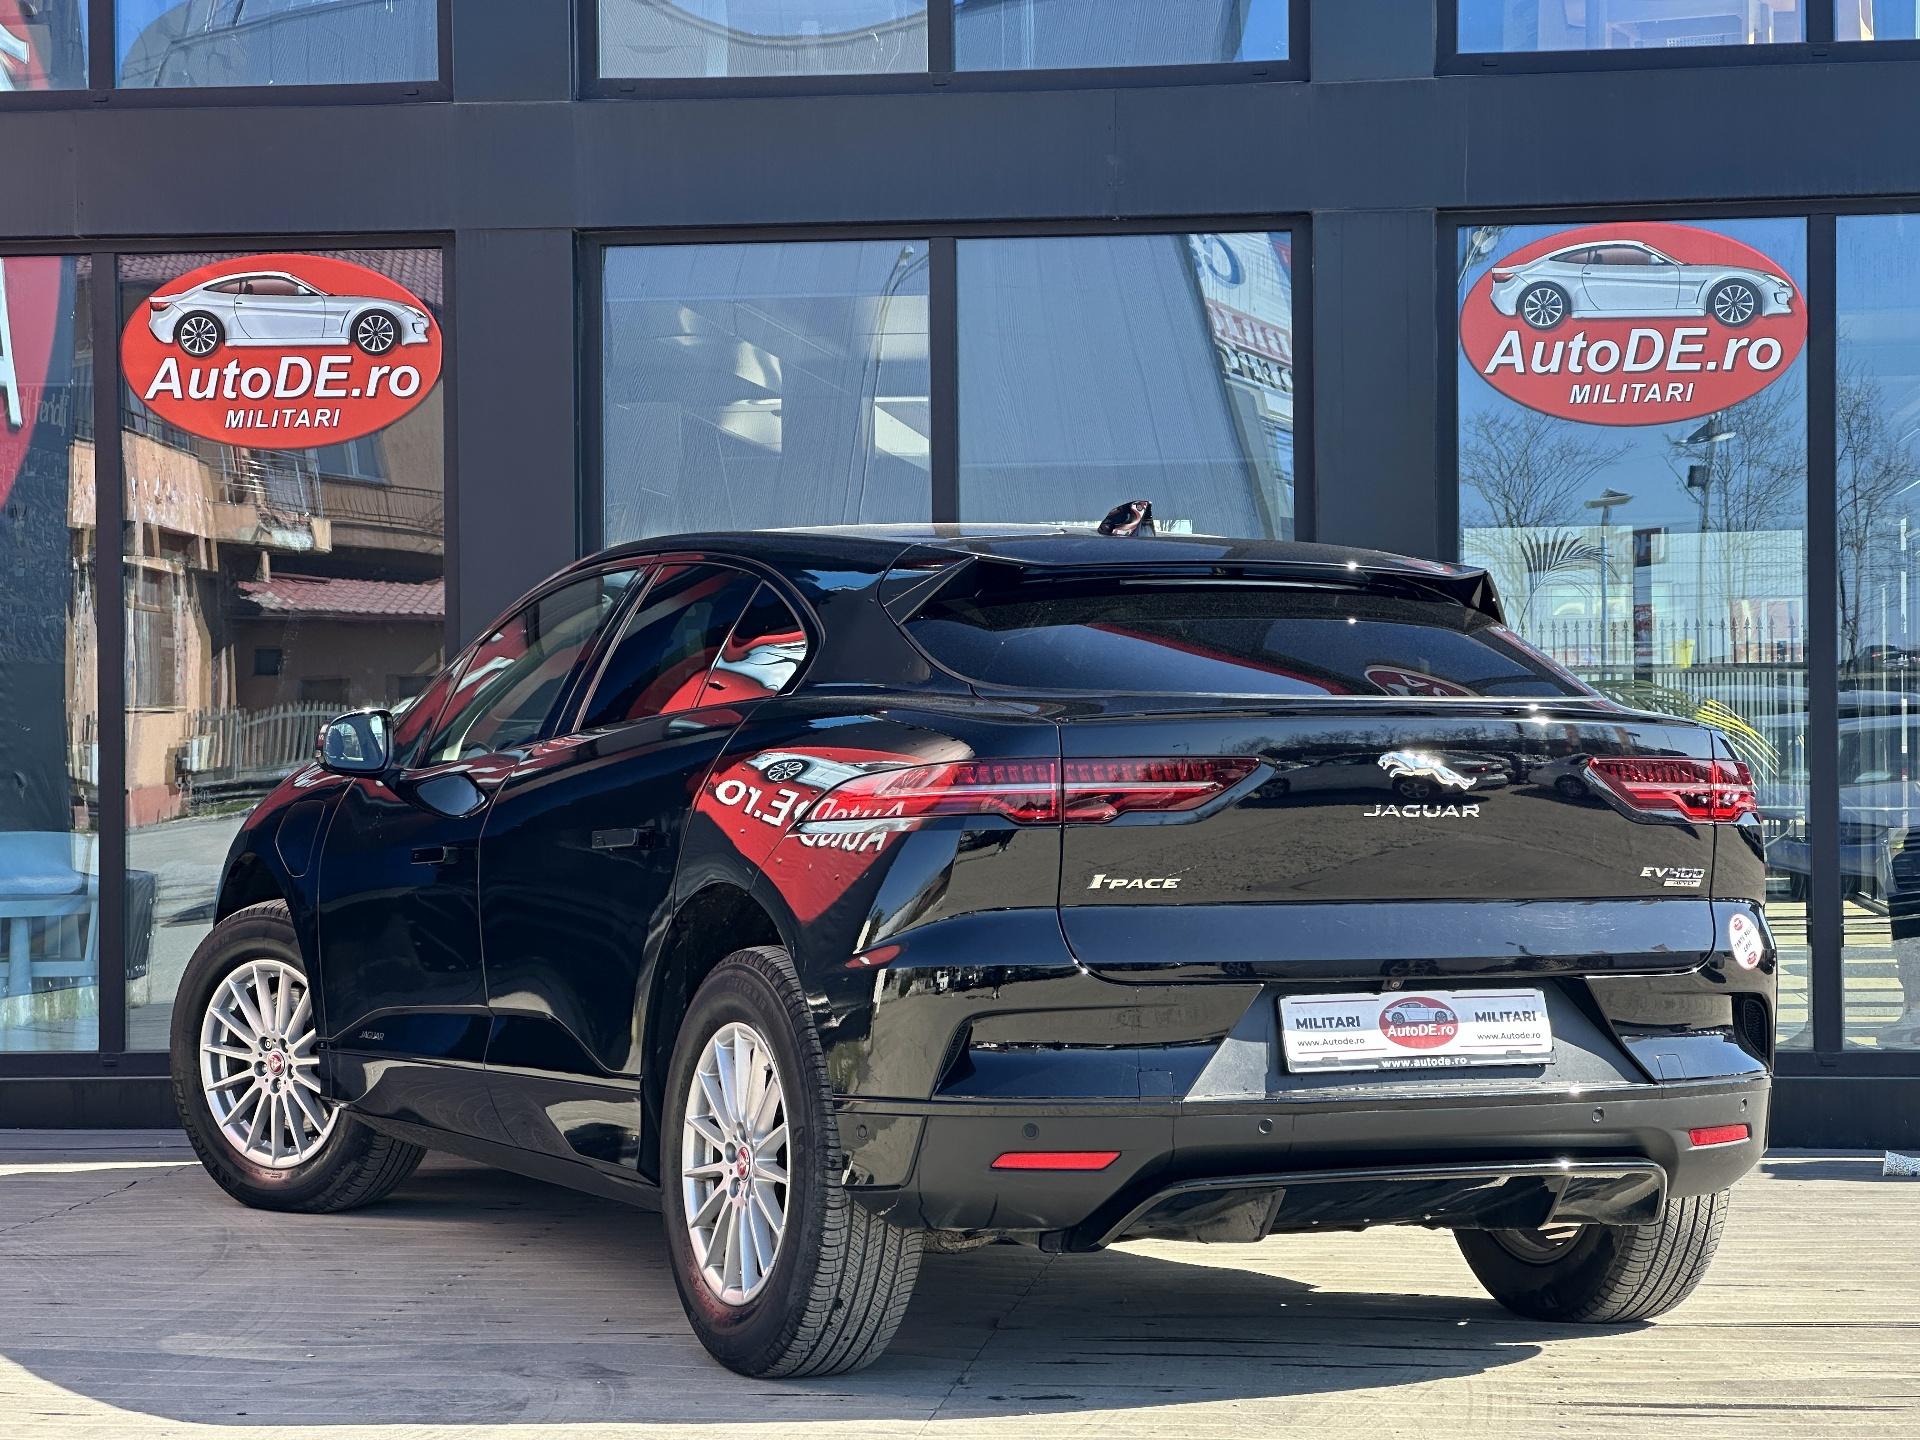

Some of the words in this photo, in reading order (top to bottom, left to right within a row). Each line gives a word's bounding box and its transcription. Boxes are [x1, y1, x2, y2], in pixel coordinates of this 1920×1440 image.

[1484, 327, 1783, 376] AutoDE.ro
[144, 355, 421, 402] AutoDE.ro
[1569, 383, 1695, 404] MILITARI
[224, 407, 341, 430] MILITARI
[1363, 803, 1480, 818] JAGUAR
[1087, 873, 1182, 890] I-PACE
[1640, 866, 1705, 878] EV400
[1295, 1015, 1361, 1030] MILITARI
[1386, 1024, 1455, 1038] AutoDE.ro
[1474, 1010, 1536, 1023] MILITARI
[1297, 1036, 1365, 1047] www.Autode.ro
[1477, 1030, 1541, 1041] www.Autode.ro
[1381, 1056, 1467, 1068] www.autode.ro
